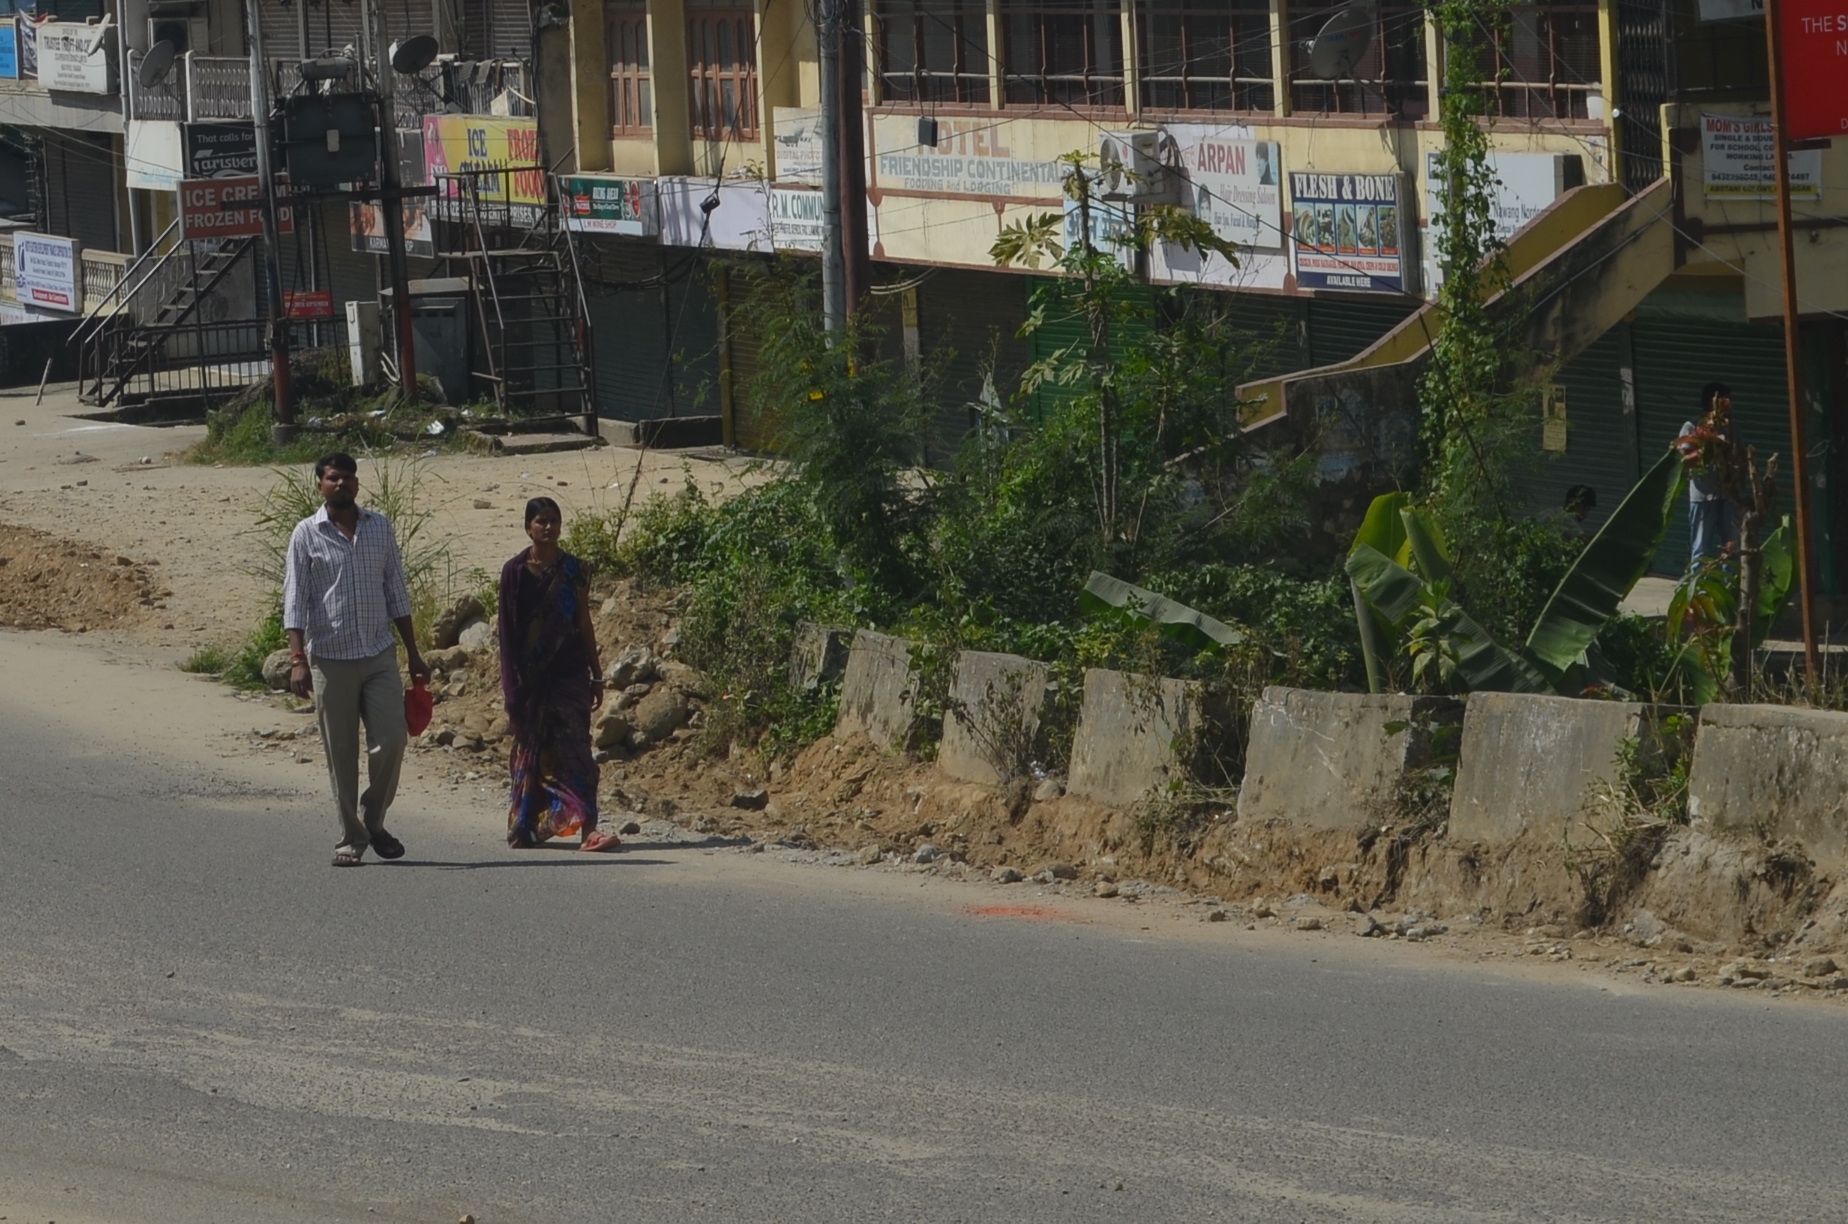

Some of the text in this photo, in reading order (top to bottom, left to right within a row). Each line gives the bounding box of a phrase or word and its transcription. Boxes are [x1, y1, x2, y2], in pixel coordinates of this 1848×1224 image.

[1801, 16, 1832, 33] THE
[1706, 118, 1740, 133] MOM'S
[196, 131, 254, 144] That calls for
[467, 128, 488, 157] ICE
[919, 119, 1010, 158] OTEL
[1714, 134, 1742, 142] SINGLE
[1728, 144, 1761, 152] SCHOOL,
[1198, 142, 1246, 176] ARPAN
[880, 156, 1064, 183] FRIENDSHIP CONTINENTAL
[904, 177, 943, 191] FOODING
[963, 181, 1011, 195] LODGING
[1294, 173, 1395, 201] FLESH & BONE
[185, 188, 216, 207] ICE
[772, 194, 791, 219] R.M.
[185, 210, 244, 229] FROZEN
[1494, 205, 1519, 222] Nawang
[1326, 275, 1372, 288] AVAILABLE HERE
